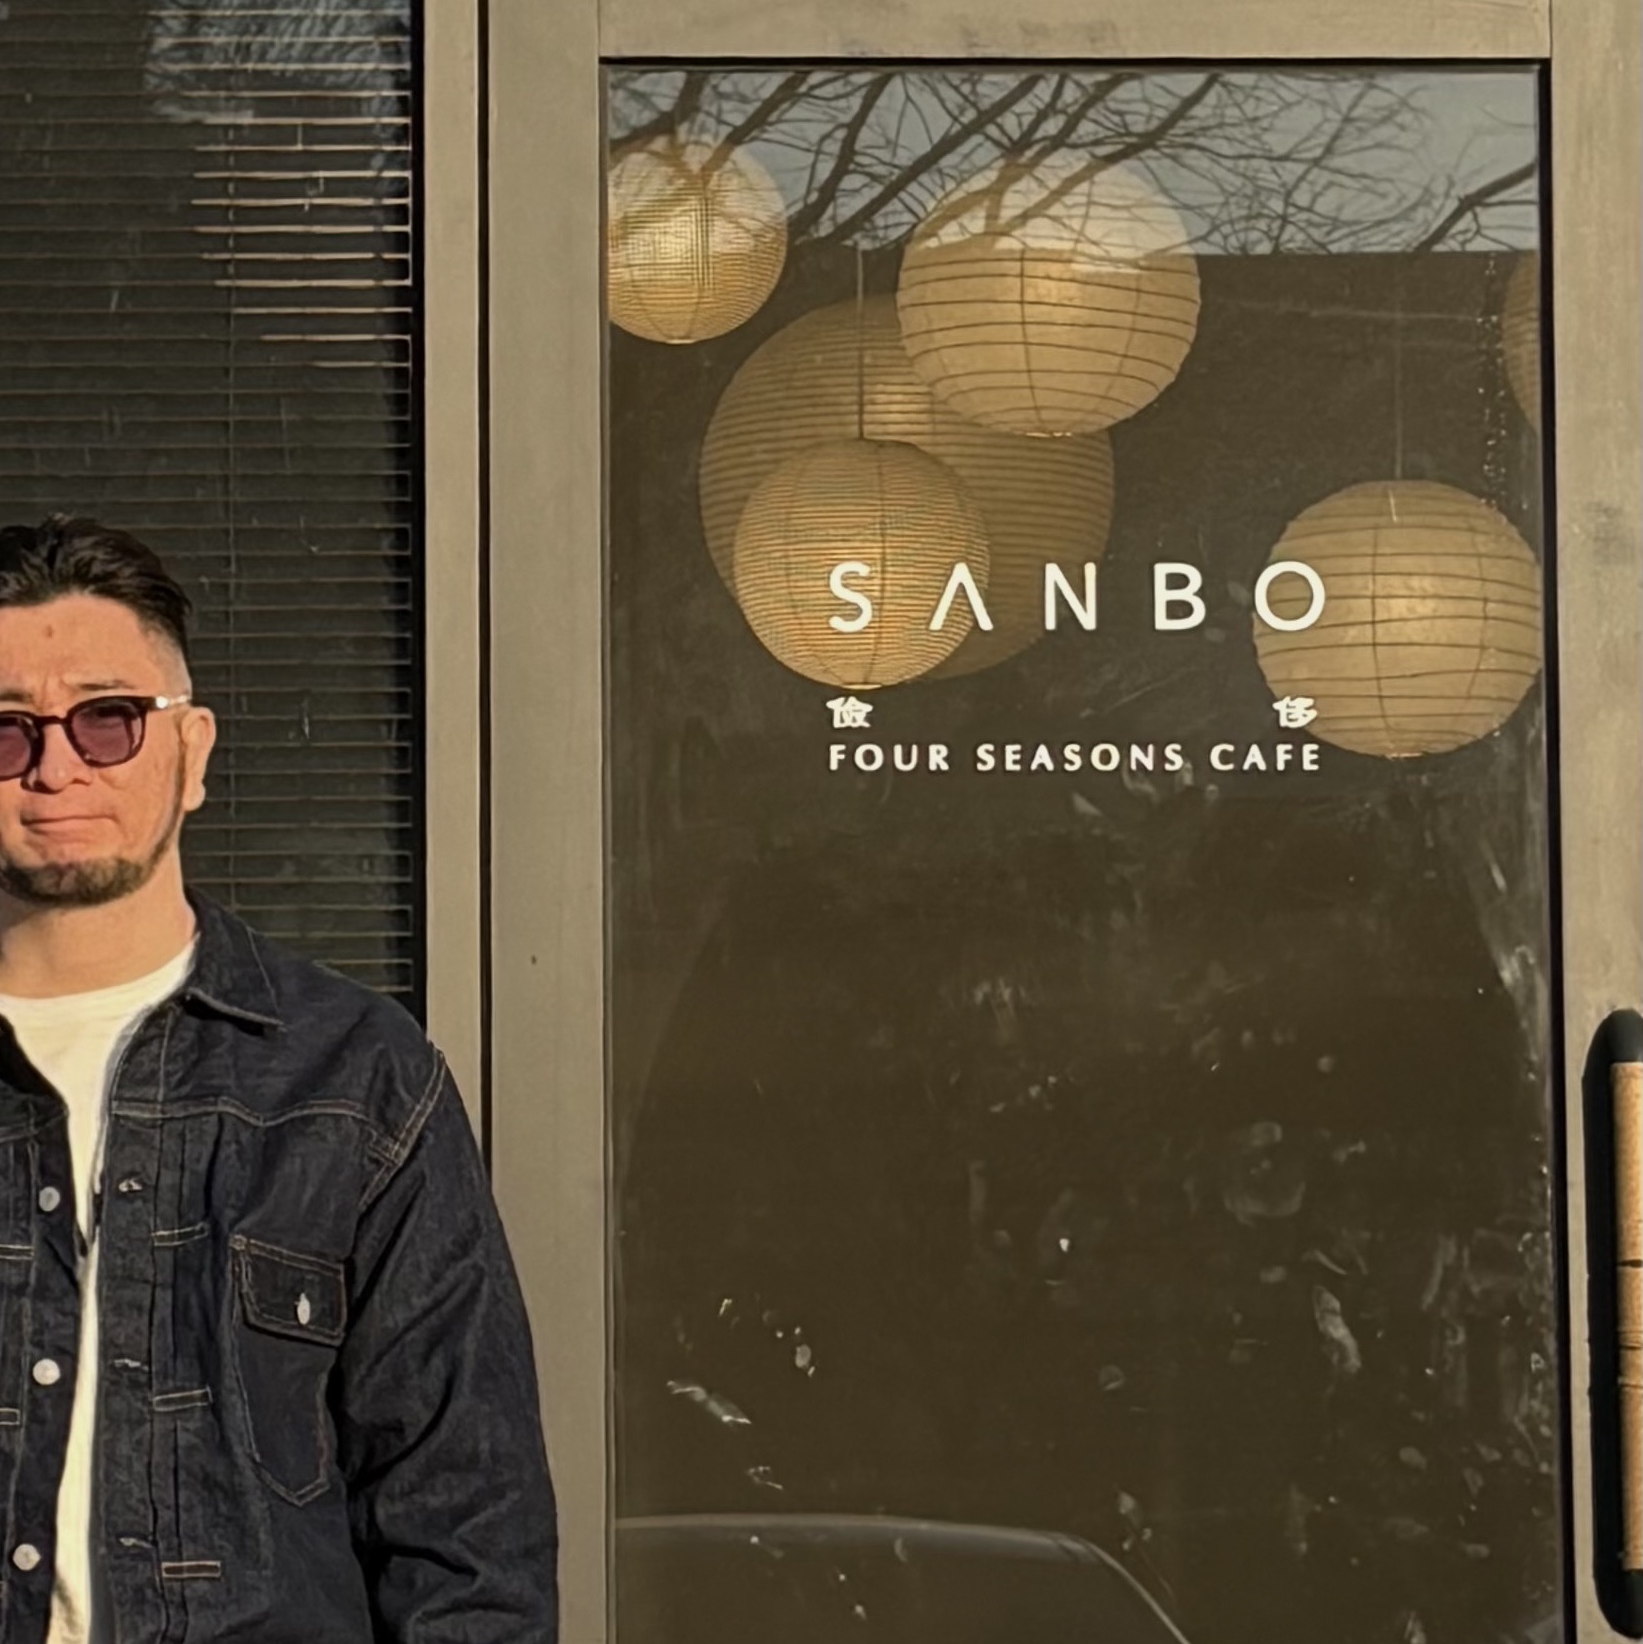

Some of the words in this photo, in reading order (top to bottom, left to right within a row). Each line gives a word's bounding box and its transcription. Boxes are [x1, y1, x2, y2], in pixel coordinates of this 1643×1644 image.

[828, 561, 1326, 633] SANBO
[829, 743, 950, 772] FOUR
[975, 743, 1184, 772] SEASONS
[1209, 743, 1321, 772] CAFE
